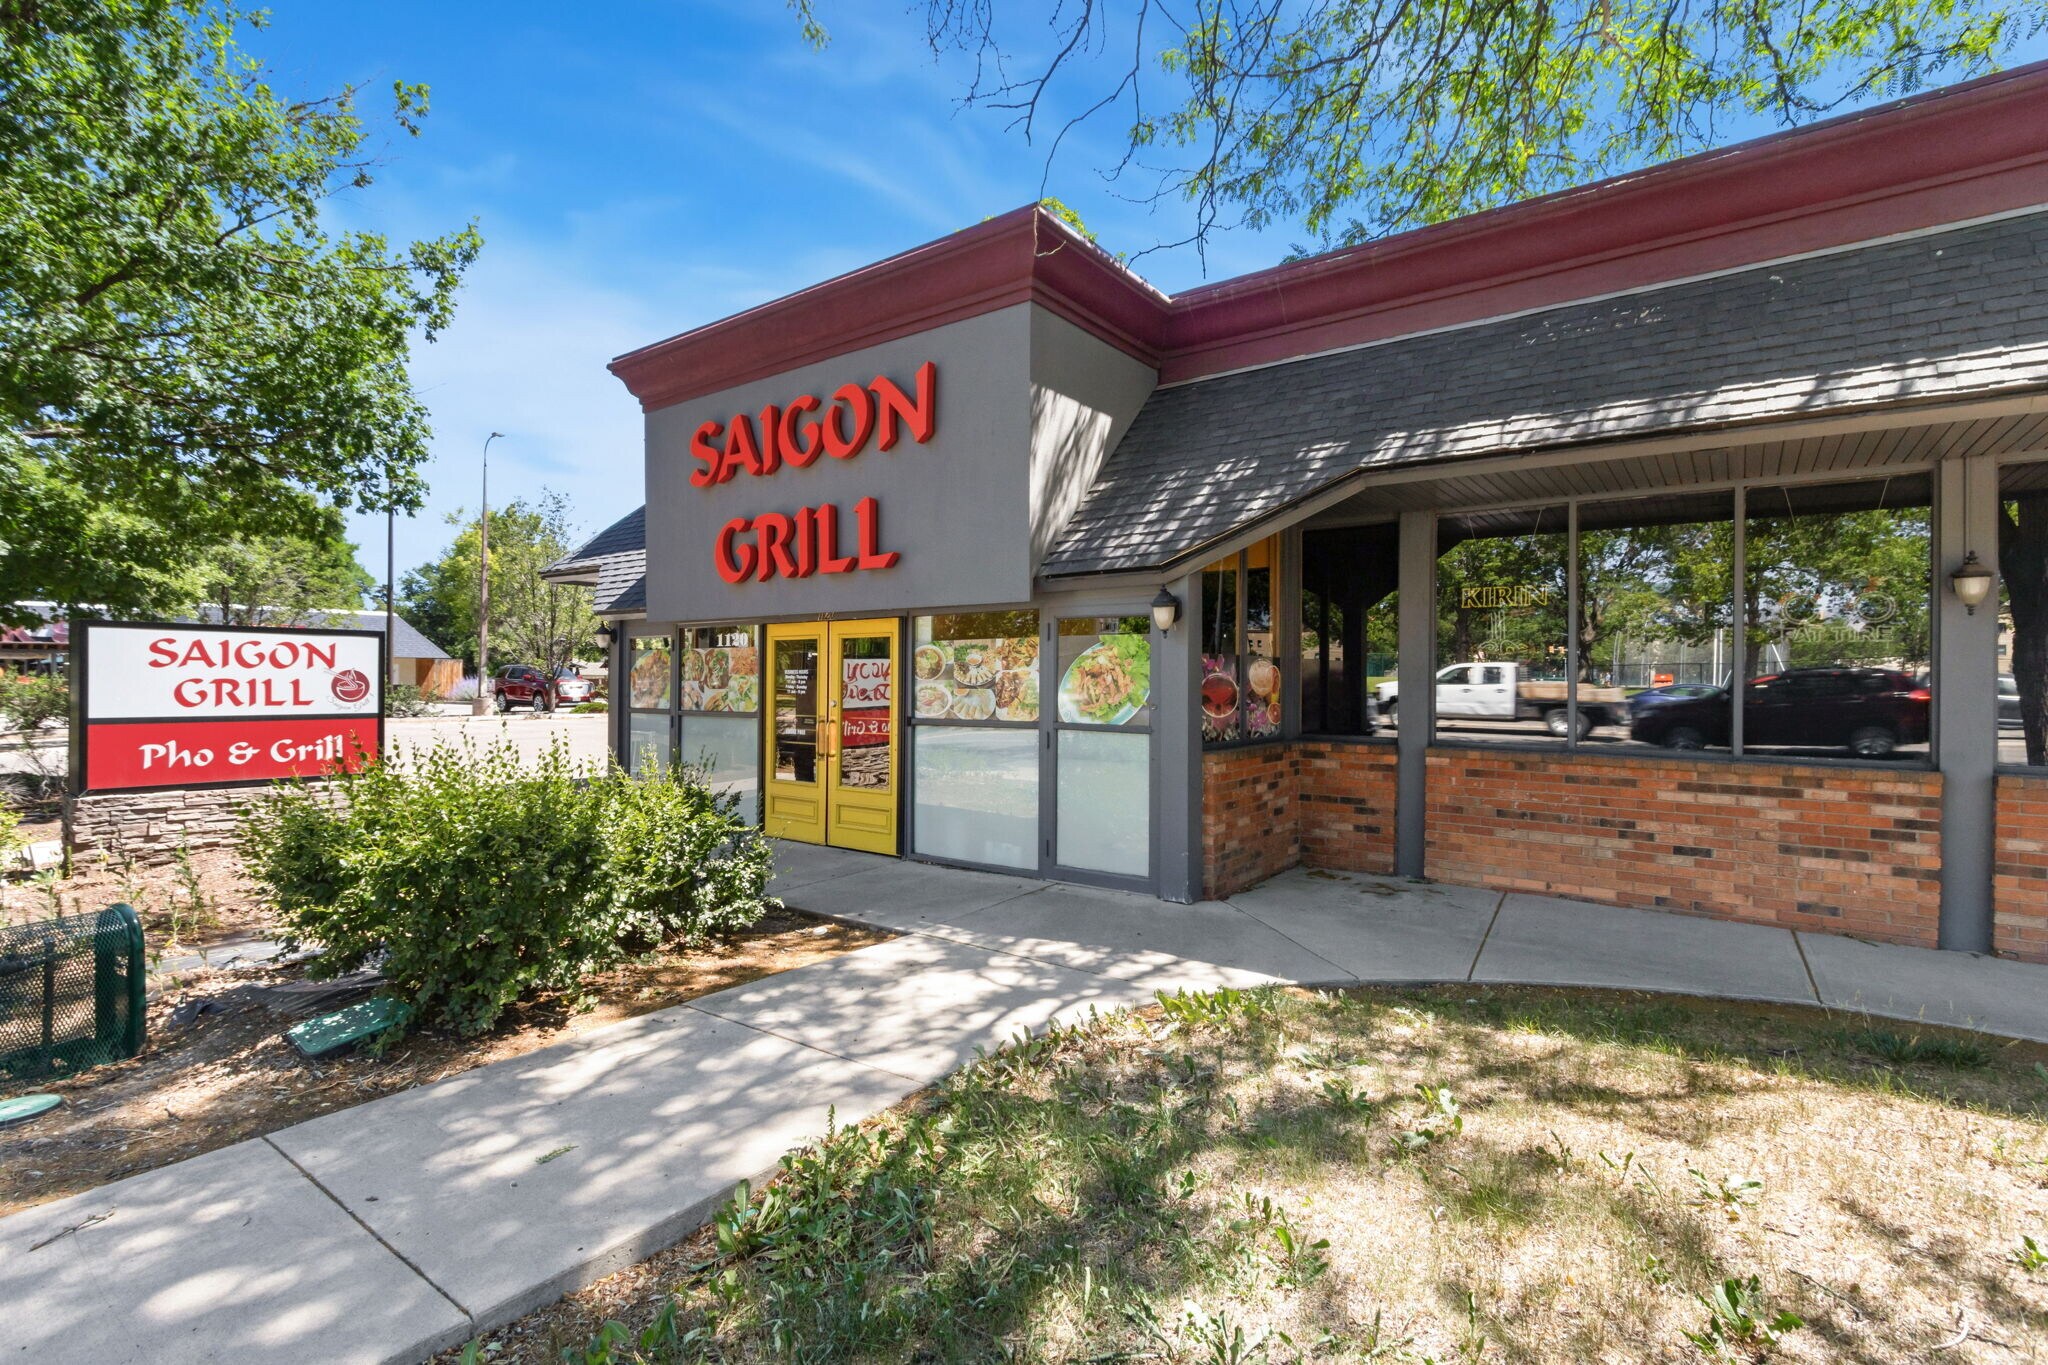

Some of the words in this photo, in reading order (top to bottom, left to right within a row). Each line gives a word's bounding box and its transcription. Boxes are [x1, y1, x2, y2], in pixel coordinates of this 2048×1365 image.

[689, 361, 936, 488] SAIGON
[714, 496, 901, 585] GRILL
[1461, 584, 1550, 609] KIRIN
[716, 632, 749, 647] 1120
[1780, 626, 1826, 643] FAT
[1831, 625, 1895, 643] TIRE
[148, 638, 336, 669] SAIGON
[173, 678, 314, 708] GRILL
[138, 740, 214, 769] Pho
[228, 741, 260, 765] &
[270, 734, 343, 763] Grill
